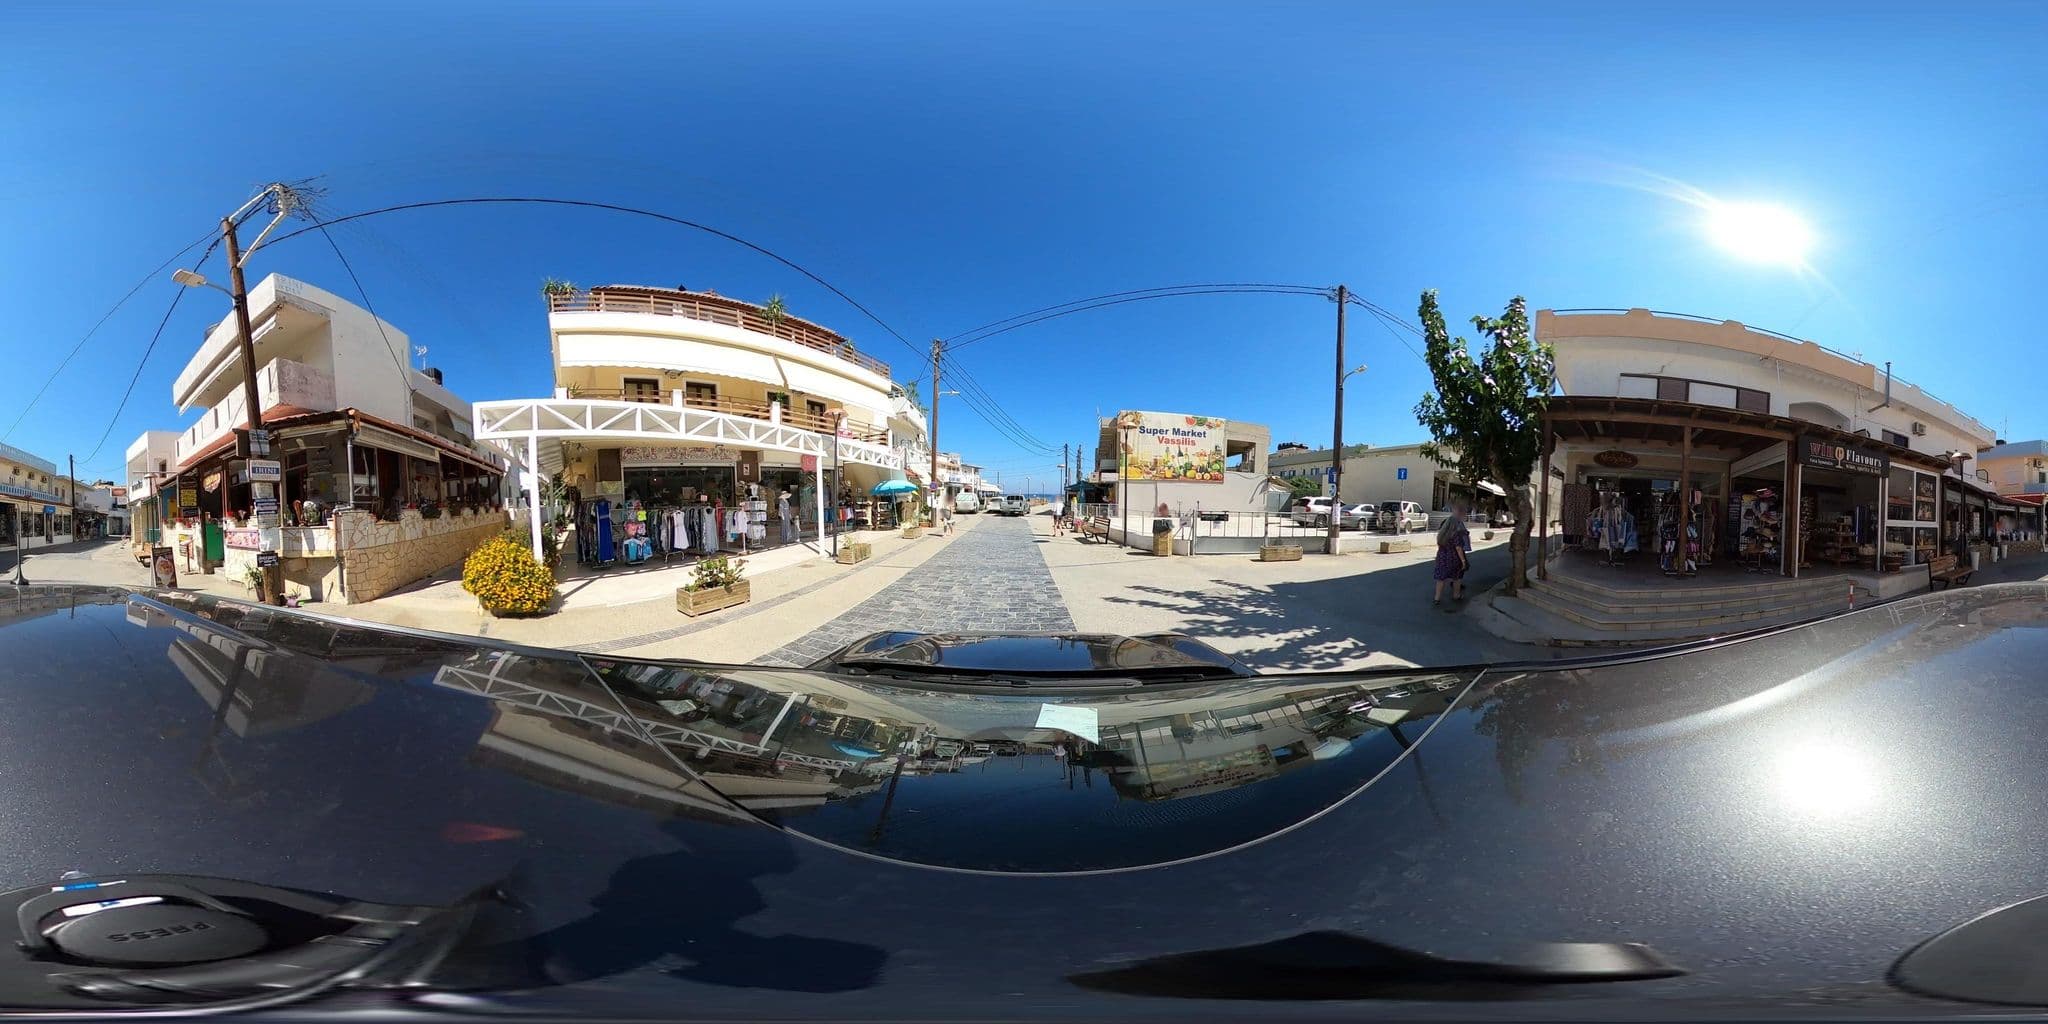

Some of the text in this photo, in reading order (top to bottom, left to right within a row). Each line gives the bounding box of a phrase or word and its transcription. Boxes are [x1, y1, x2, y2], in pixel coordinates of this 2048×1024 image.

[1139, 426, 1207, 438] Super Market
[1157, 436, 1197, 446] Vassilis
[1846, 449, 1882, 467] Flavours
[108, 921, 212, 942] PRESS
